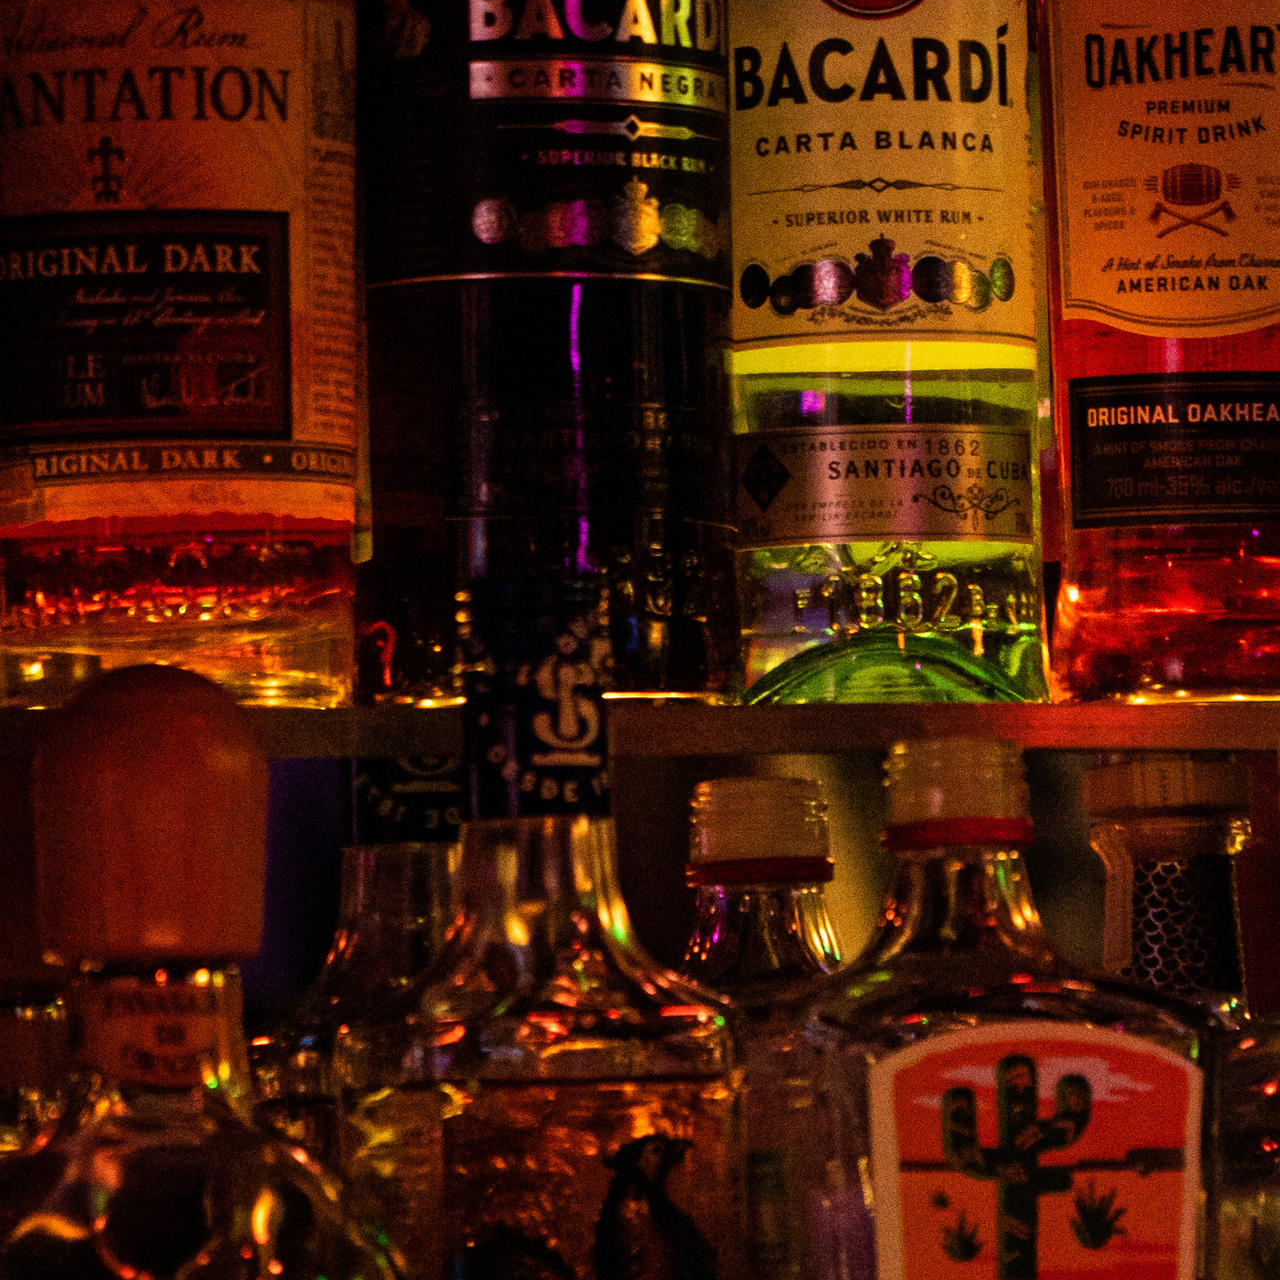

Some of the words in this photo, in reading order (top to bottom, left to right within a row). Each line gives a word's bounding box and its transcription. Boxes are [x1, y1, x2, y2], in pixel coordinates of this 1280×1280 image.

[734, 24, 1009, 111] BACARDÍ
[511, 72, 622, 91] CARTA
[640, 73, 718, 98] NEGRA
[1146, 100, 1231, 115] PREMIUM
[1117, 120, 1187, 144] SPIRIT
[1197, 115, 1268, 144] DRINK
[757, 131, 858, 157] CARTA
[875, 132, 994, 153] BLANCA
[785, 211, 870, 227] SUPERIOR
[878, 211, 934, 224] WHITE
[0, 243, 148, 282] RIGINAL
[163, 242, 262, 273] DARK
[1116, 276, 1221, 294] AMERICAN
[1228, 275, 1269, 291] OAK
[1086, 404, 1180, 428] ORIGINAL
[925, 439, 981, 456] 1862
[161, 450, 242, 471] DARK
[828, 458, 961, 481] SANTIAGO
